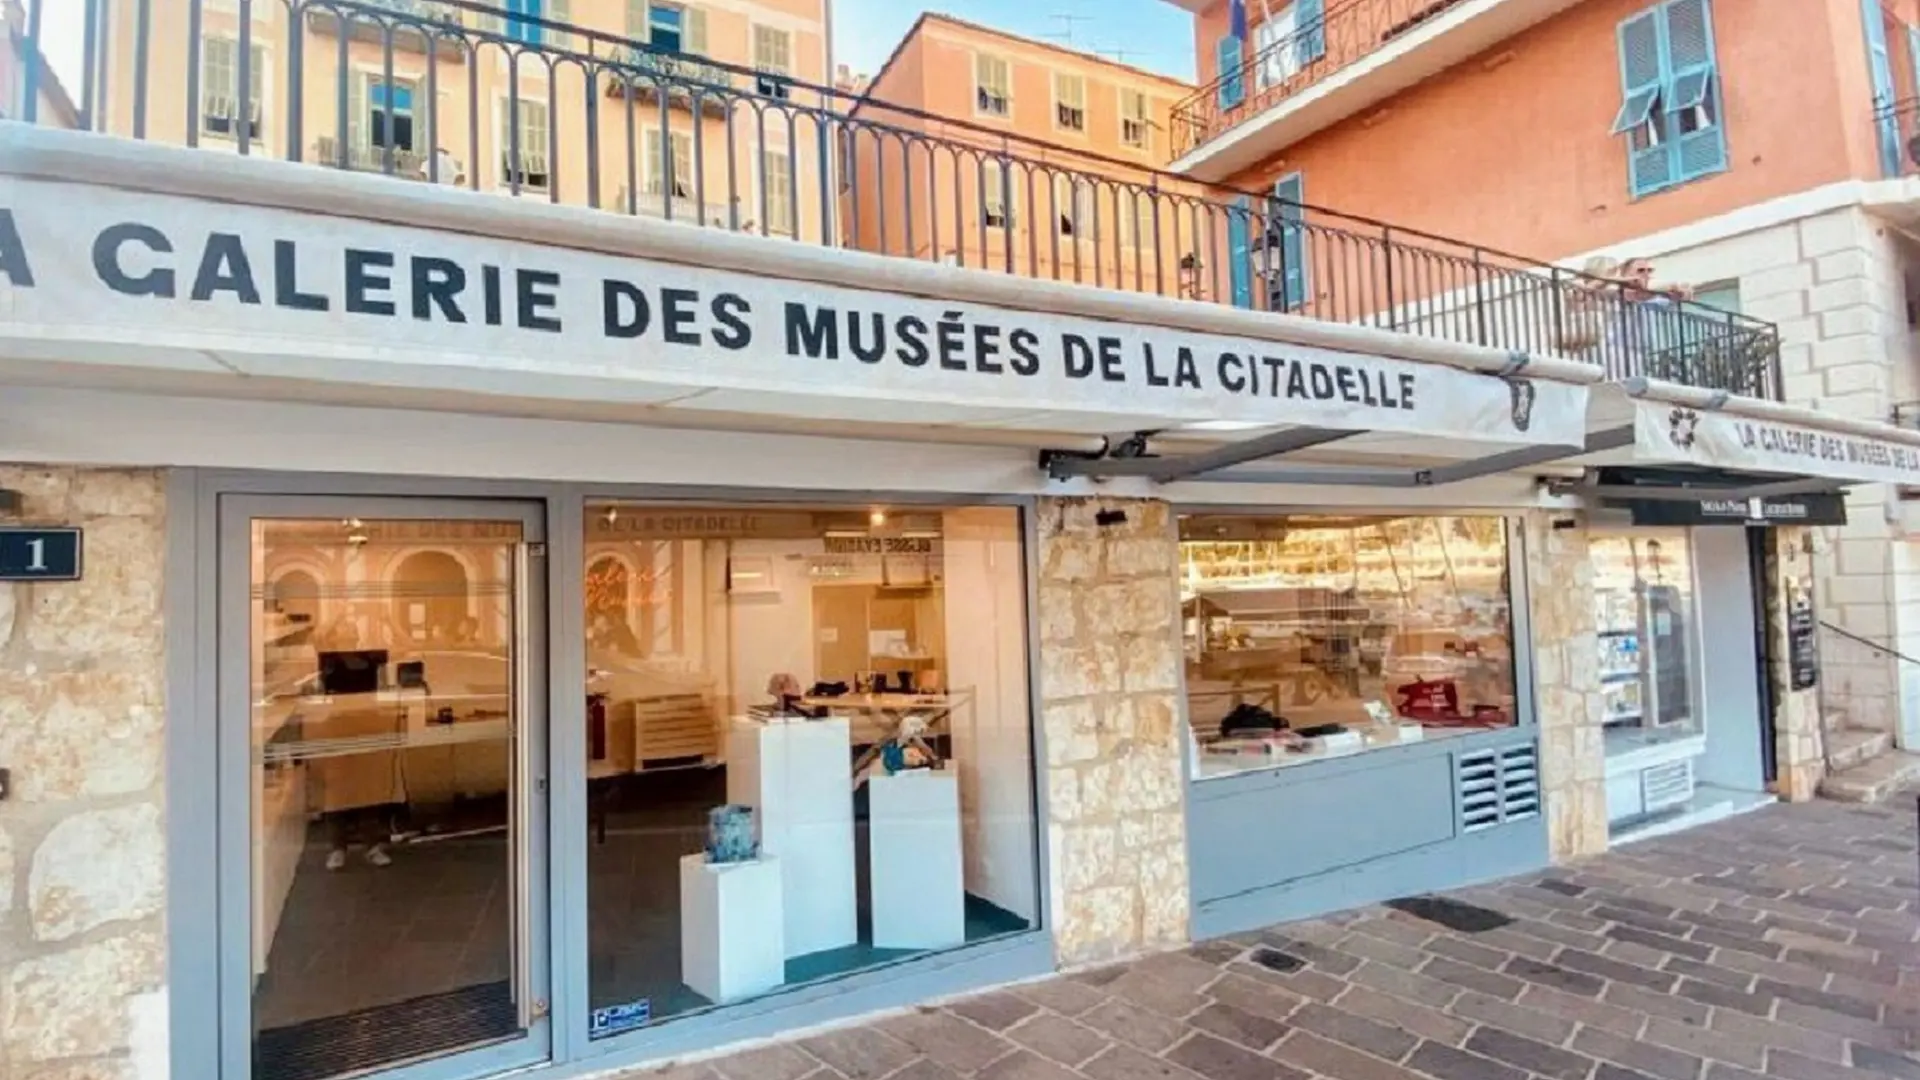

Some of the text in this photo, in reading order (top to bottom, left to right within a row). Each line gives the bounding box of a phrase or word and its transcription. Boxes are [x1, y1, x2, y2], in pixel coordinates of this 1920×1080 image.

[92, 222, 563, 334] GALERIE
[602, 278, 752, 351] DES
[784, 301, 1040, 378] MUSÉES
[1061, 333, 1126, 382] DE
[1143, 342, 1201, 389] LA
[1217, 352, 1415, 411] CITADELLE
[25, 538, 48, 570] 1
